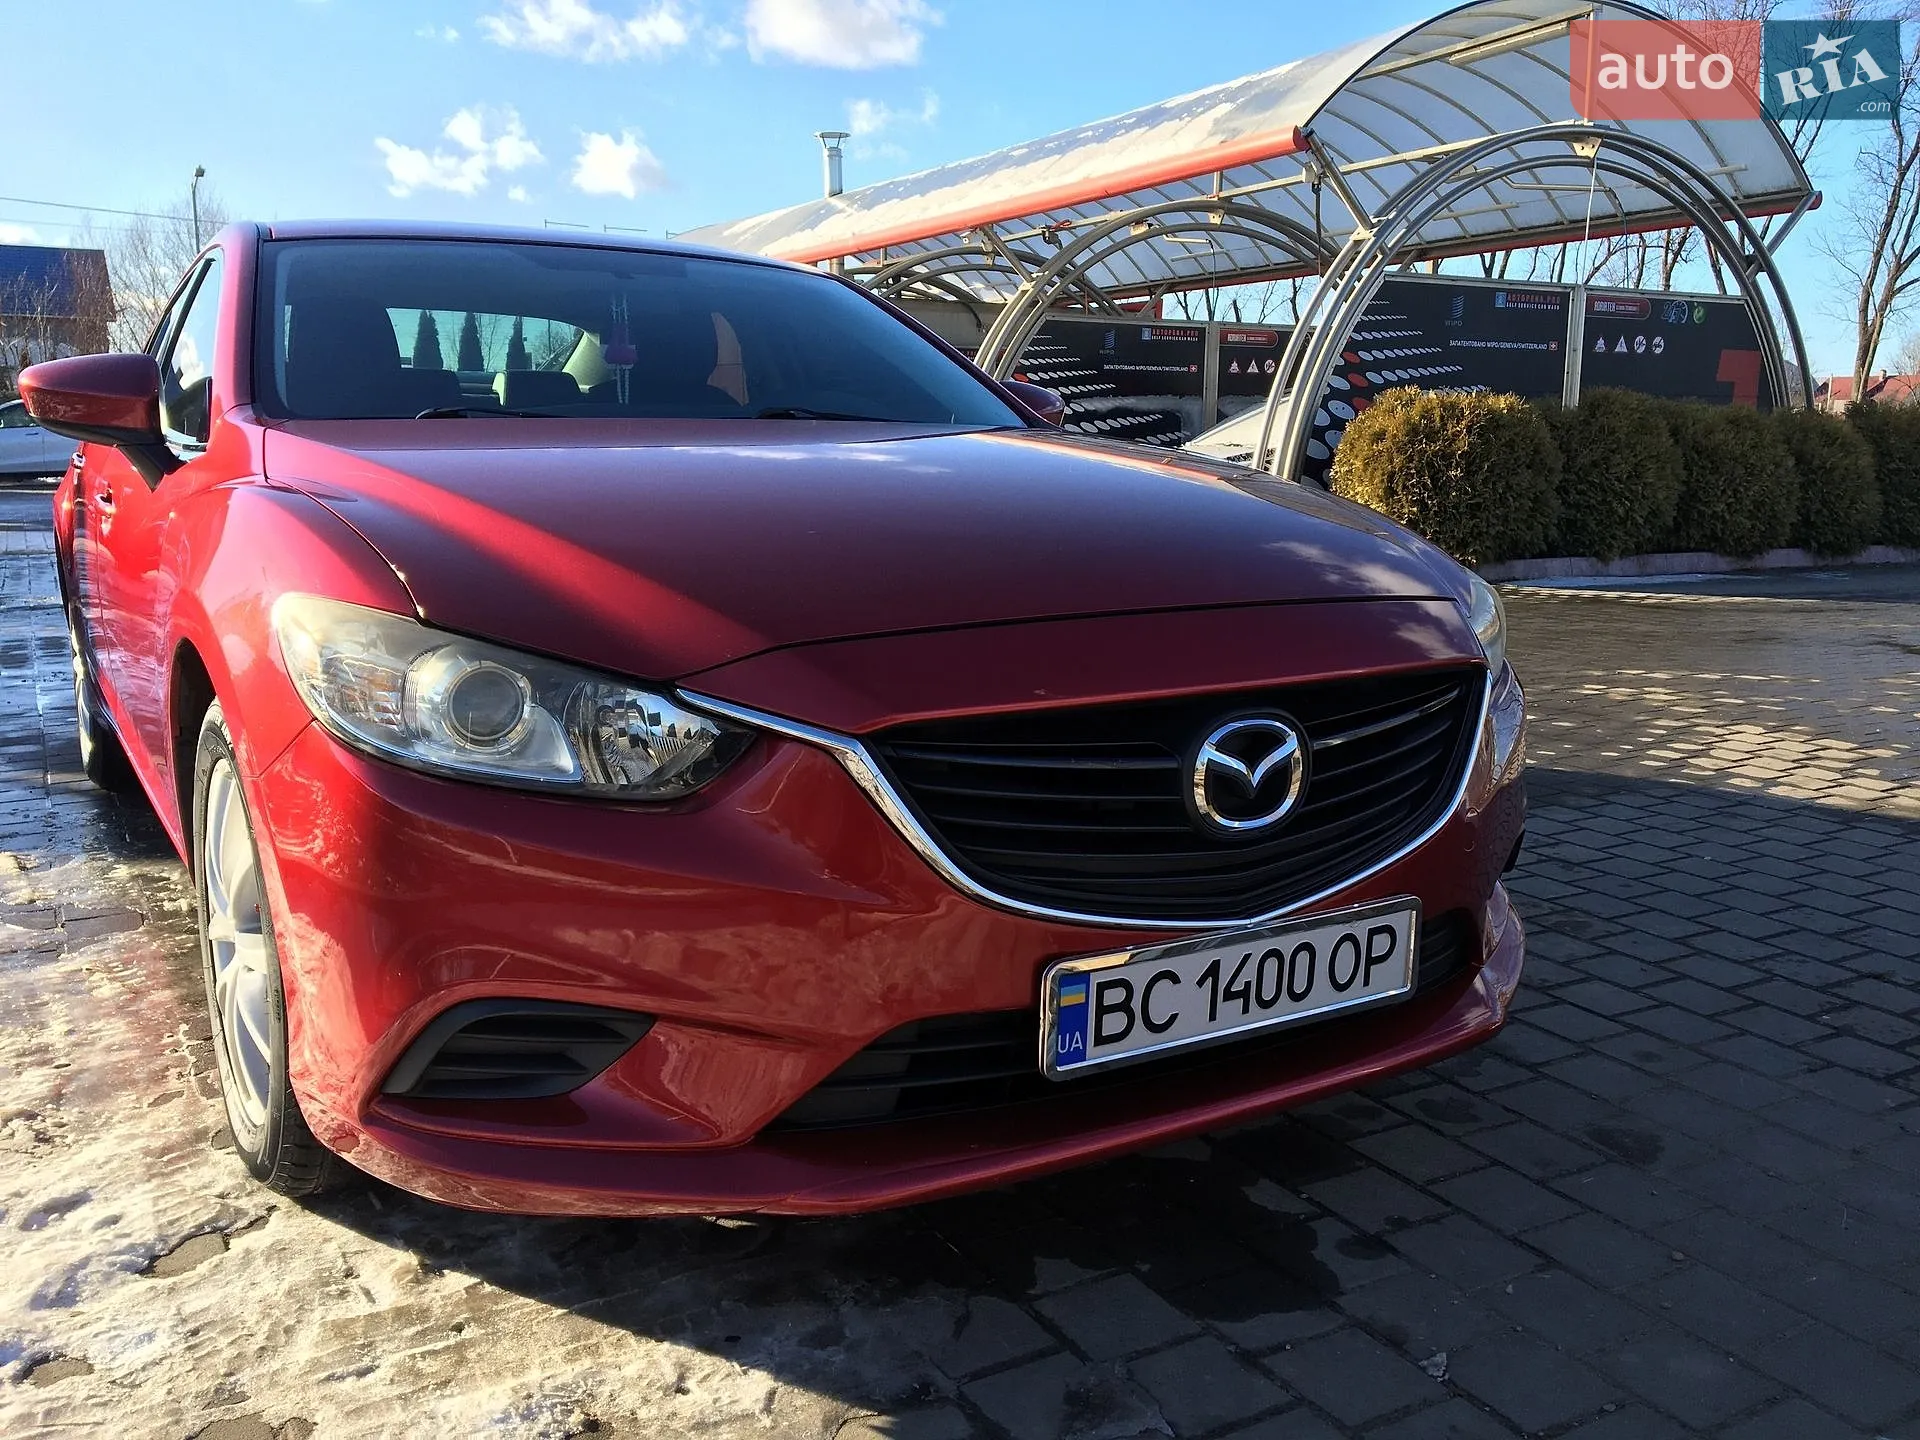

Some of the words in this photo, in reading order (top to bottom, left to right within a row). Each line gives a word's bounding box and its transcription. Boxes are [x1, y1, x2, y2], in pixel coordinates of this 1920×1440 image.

[1092, 969, 1182, 1047] BC
[1196, 941, 1317, 1022] 1400
[1328, 924, 1398, 993] OP
[1057, 1033, 1083, 1054] UA
